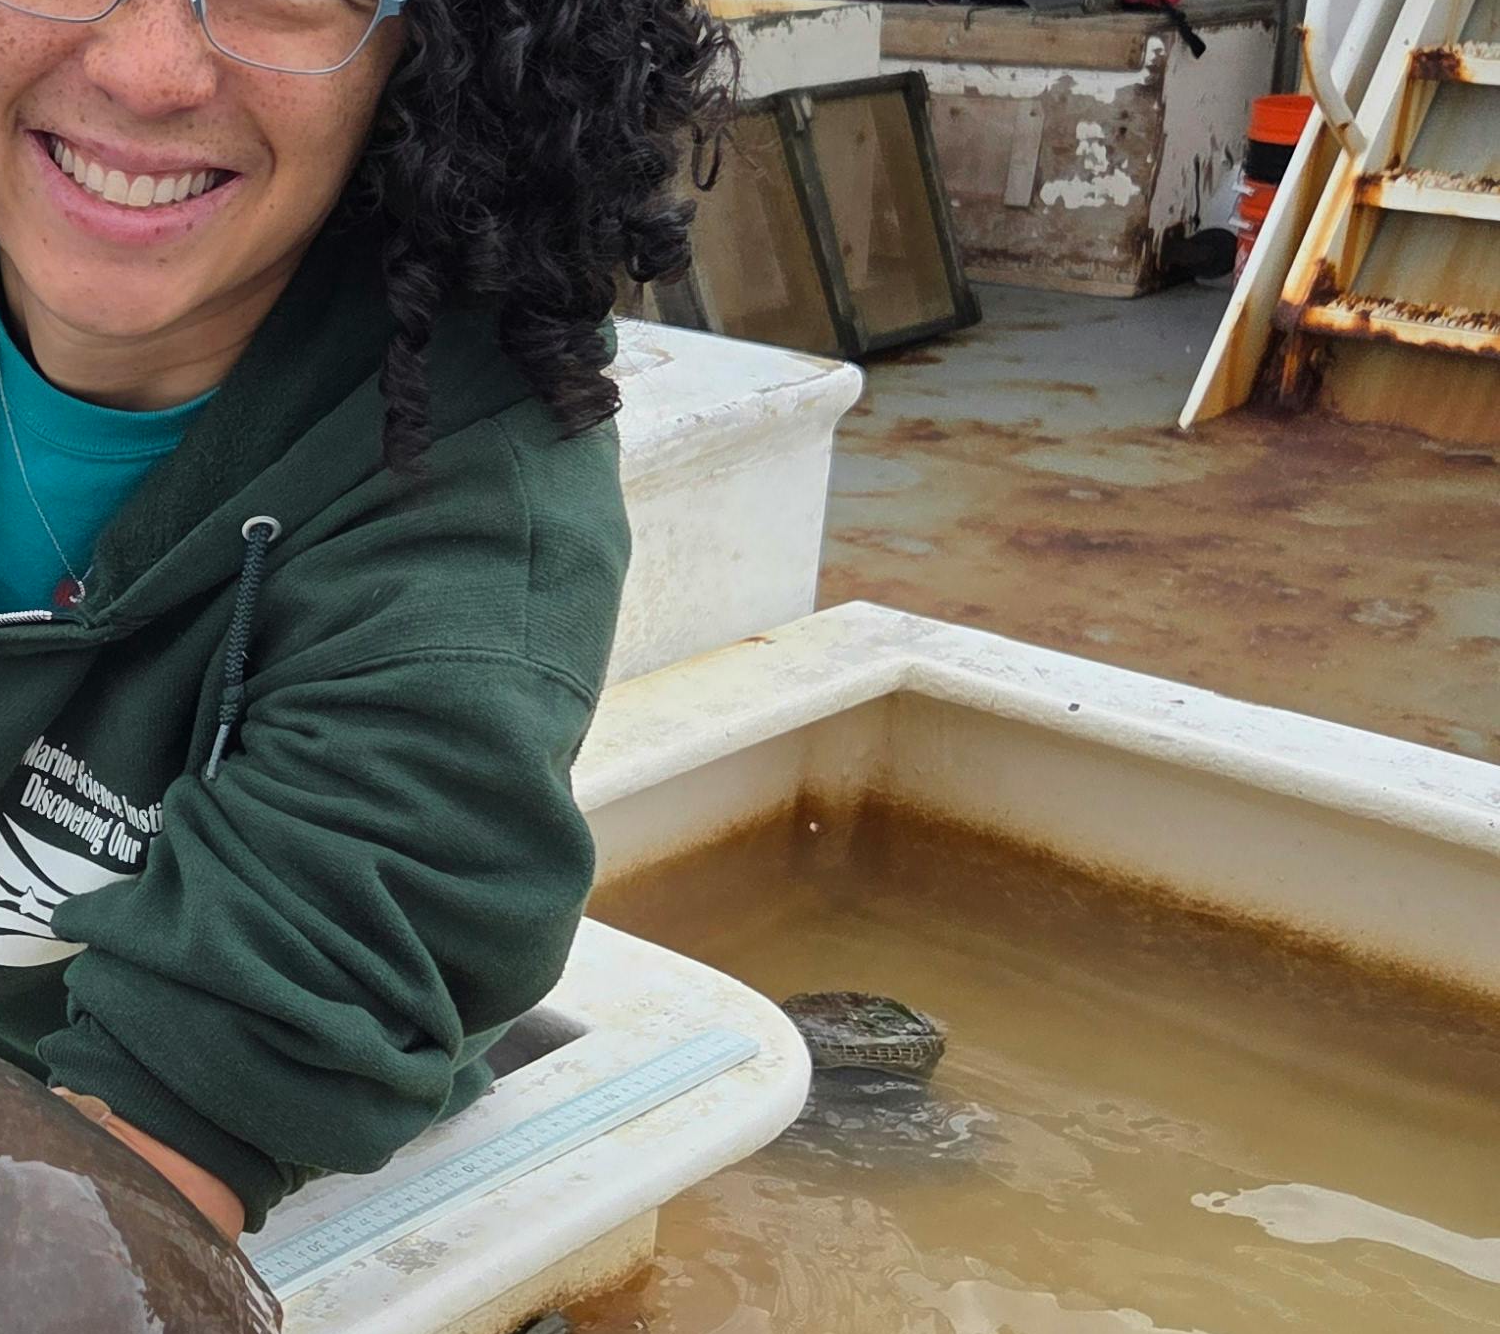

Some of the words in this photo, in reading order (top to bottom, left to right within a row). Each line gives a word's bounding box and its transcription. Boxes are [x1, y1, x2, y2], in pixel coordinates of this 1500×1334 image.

[20, 773, 113, 855] Discovering
[108, 821, 142, 864] Our
[21, 735, 77, 785] Marine
[76, 760, 124, 818] Science
